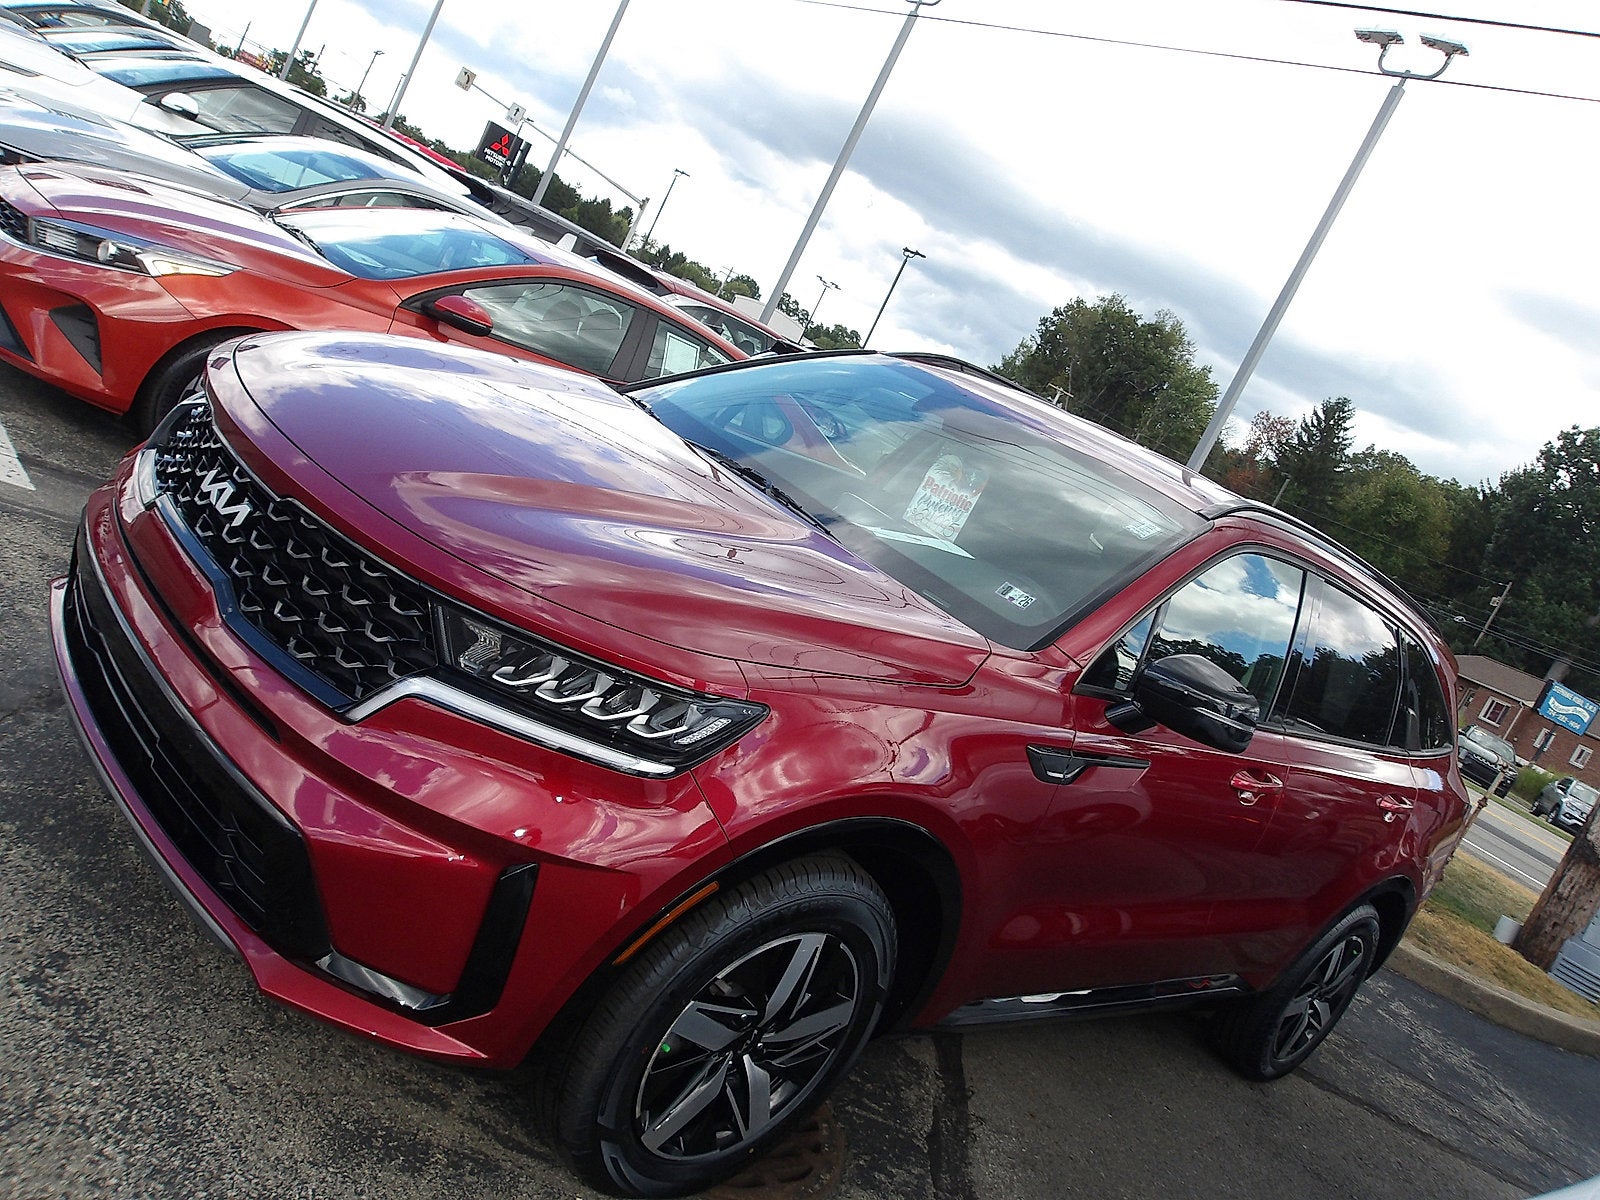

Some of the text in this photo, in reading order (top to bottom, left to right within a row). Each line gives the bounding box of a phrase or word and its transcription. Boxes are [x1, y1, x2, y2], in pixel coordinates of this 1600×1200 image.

[485, 155, 505, 167] MOTOR
[922, 476, 973, 513] Patriotic
[1018, 595, 1034, 608] 26
